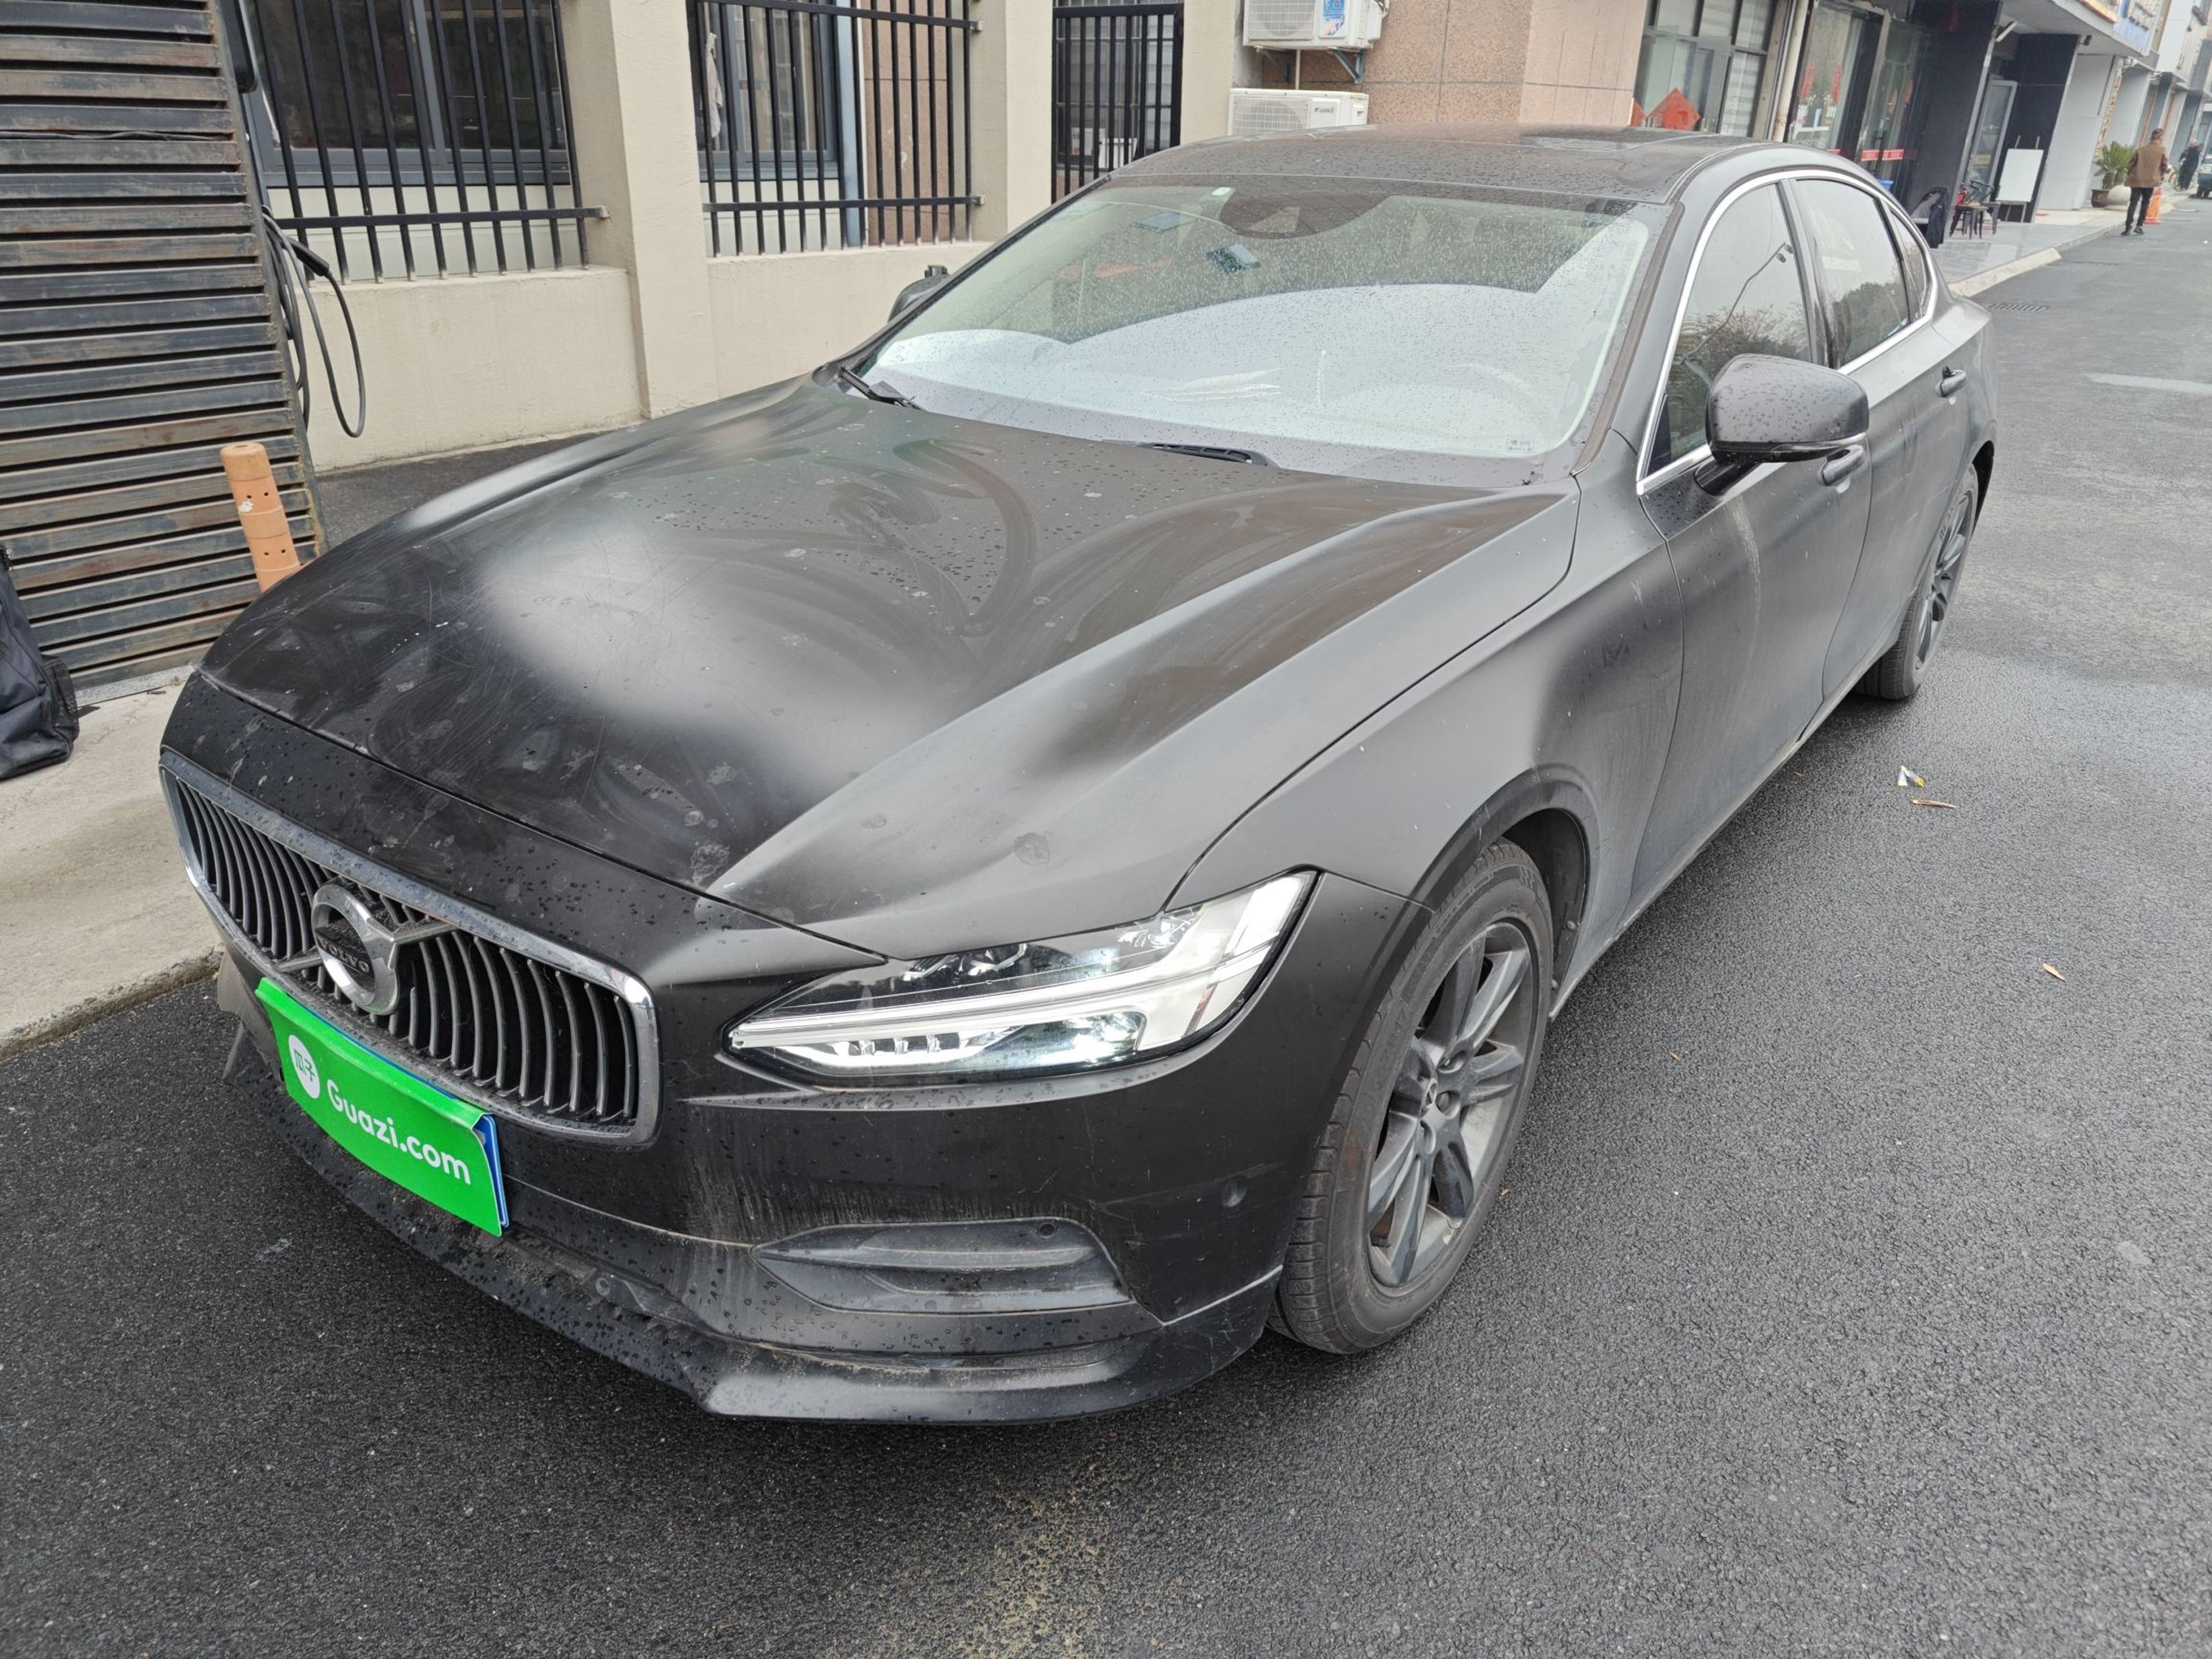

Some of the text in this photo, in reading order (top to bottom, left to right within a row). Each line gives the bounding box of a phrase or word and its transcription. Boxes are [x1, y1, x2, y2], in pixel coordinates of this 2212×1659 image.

[317, 935, 370, 974] VOLVO
[294, 1050, 316, 1082] 瓜子
[327, 1079, 471, 1185] Guazi.com
